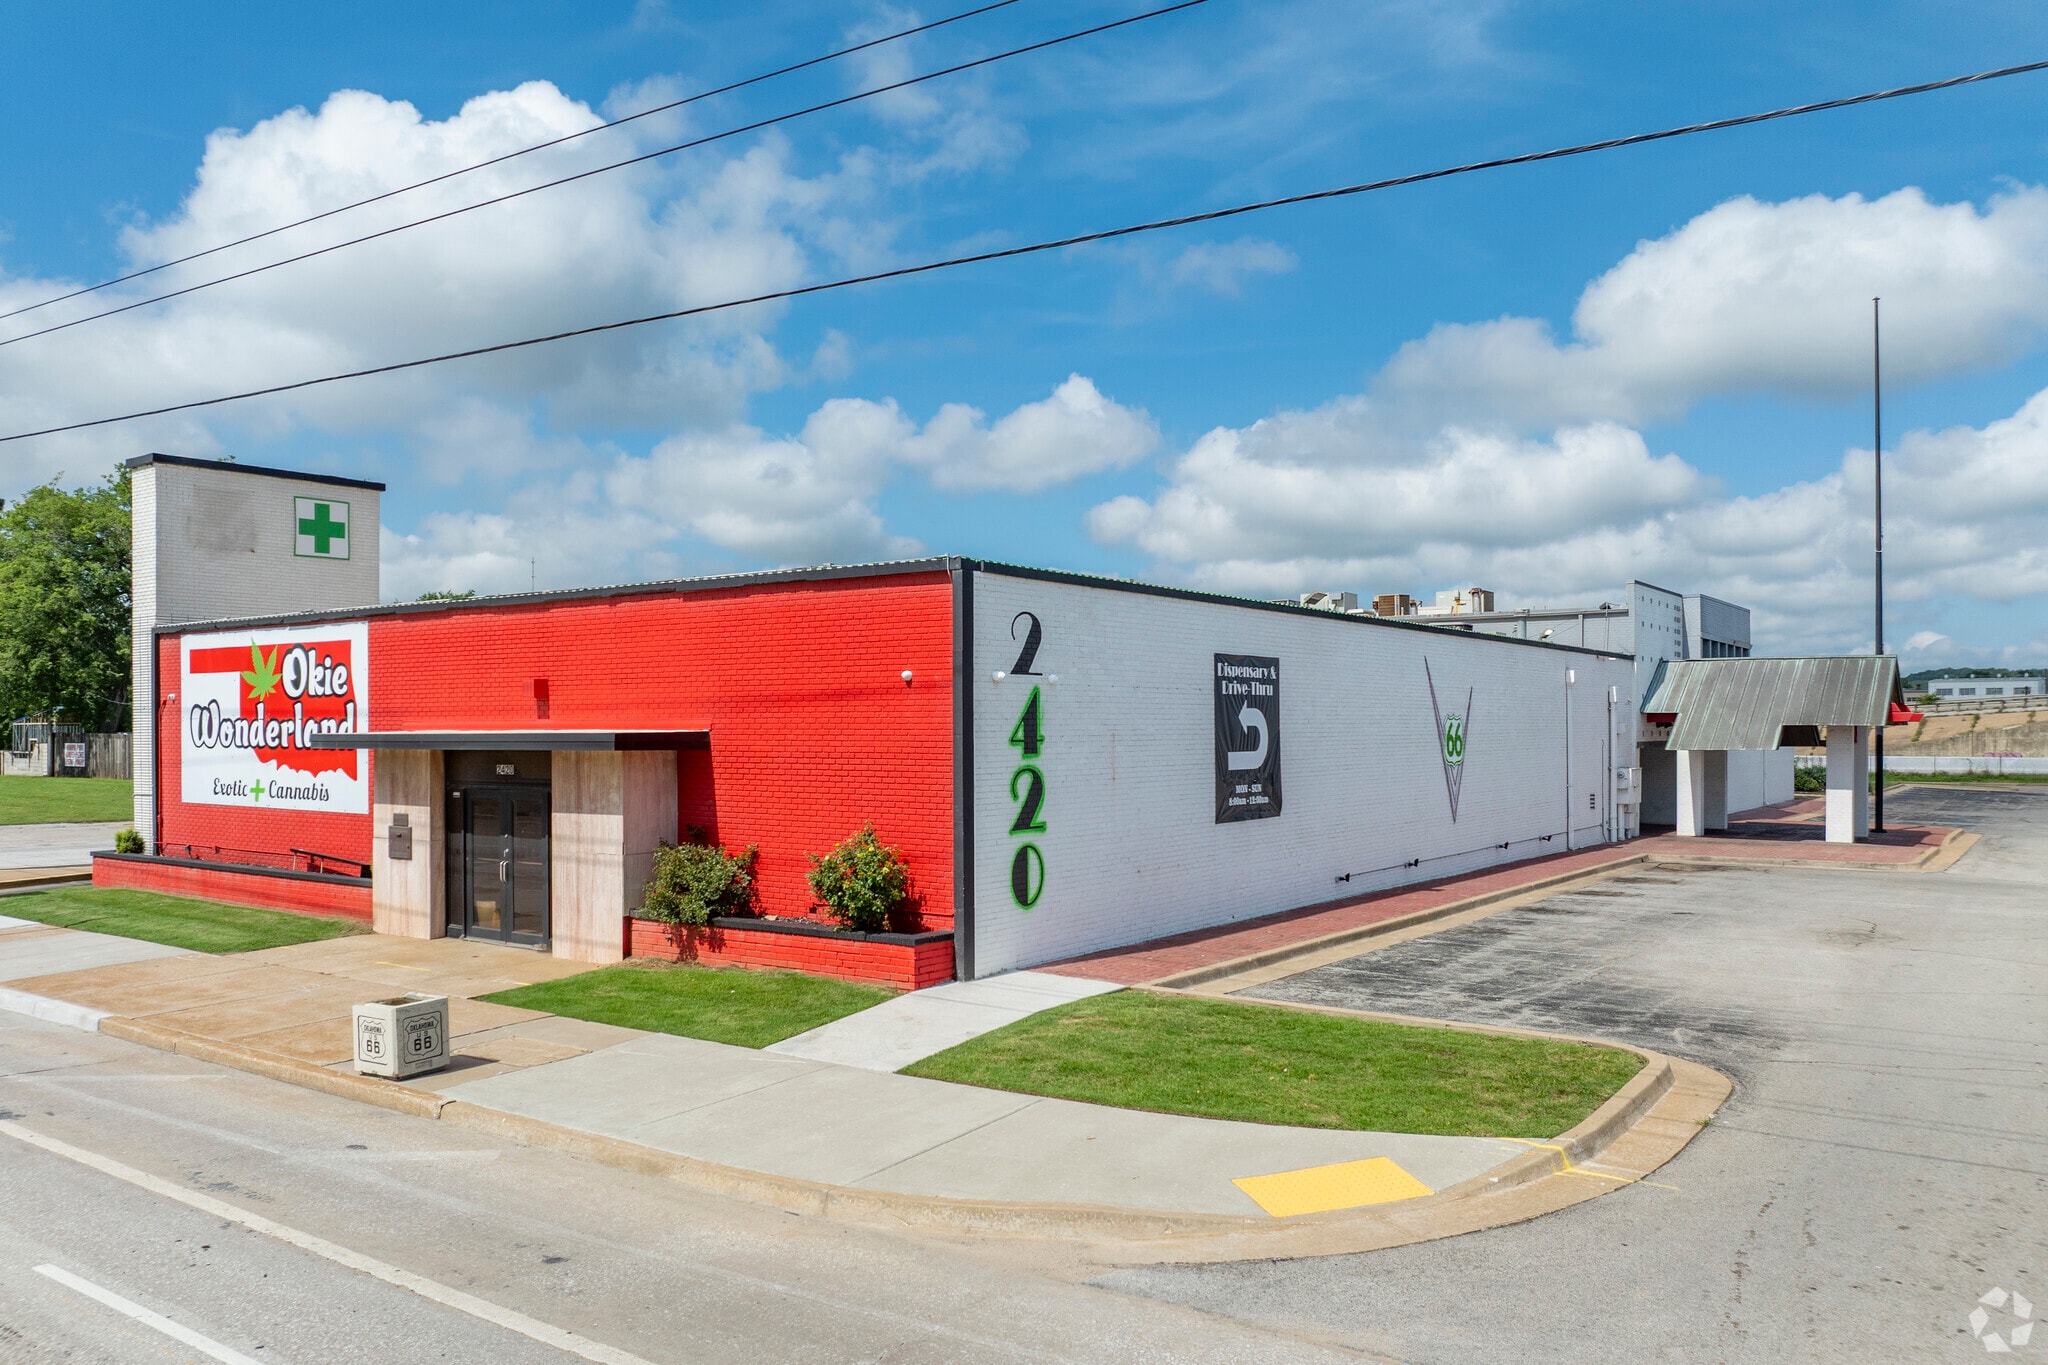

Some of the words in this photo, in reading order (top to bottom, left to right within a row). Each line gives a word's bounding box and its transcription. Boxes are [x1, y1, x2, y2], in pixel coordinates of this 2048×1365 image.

[281, 643, 349, 699] Okie
[1217, 662, 1270, 679] Dispensary
[1270, 666, 1277, 679] &
[1221, 680, 1273, 696] Drive-Thru
[1446, 722, 1463, 757] 66
[213, 777, 248, 797] Exotic
[269, 781, 330, 801] Cannabis
[410, 1021, 434, 1032] OKLAHOMA
[366, 1040, 380, 1054] 66
[414, 1036, 431, 1051] 66
